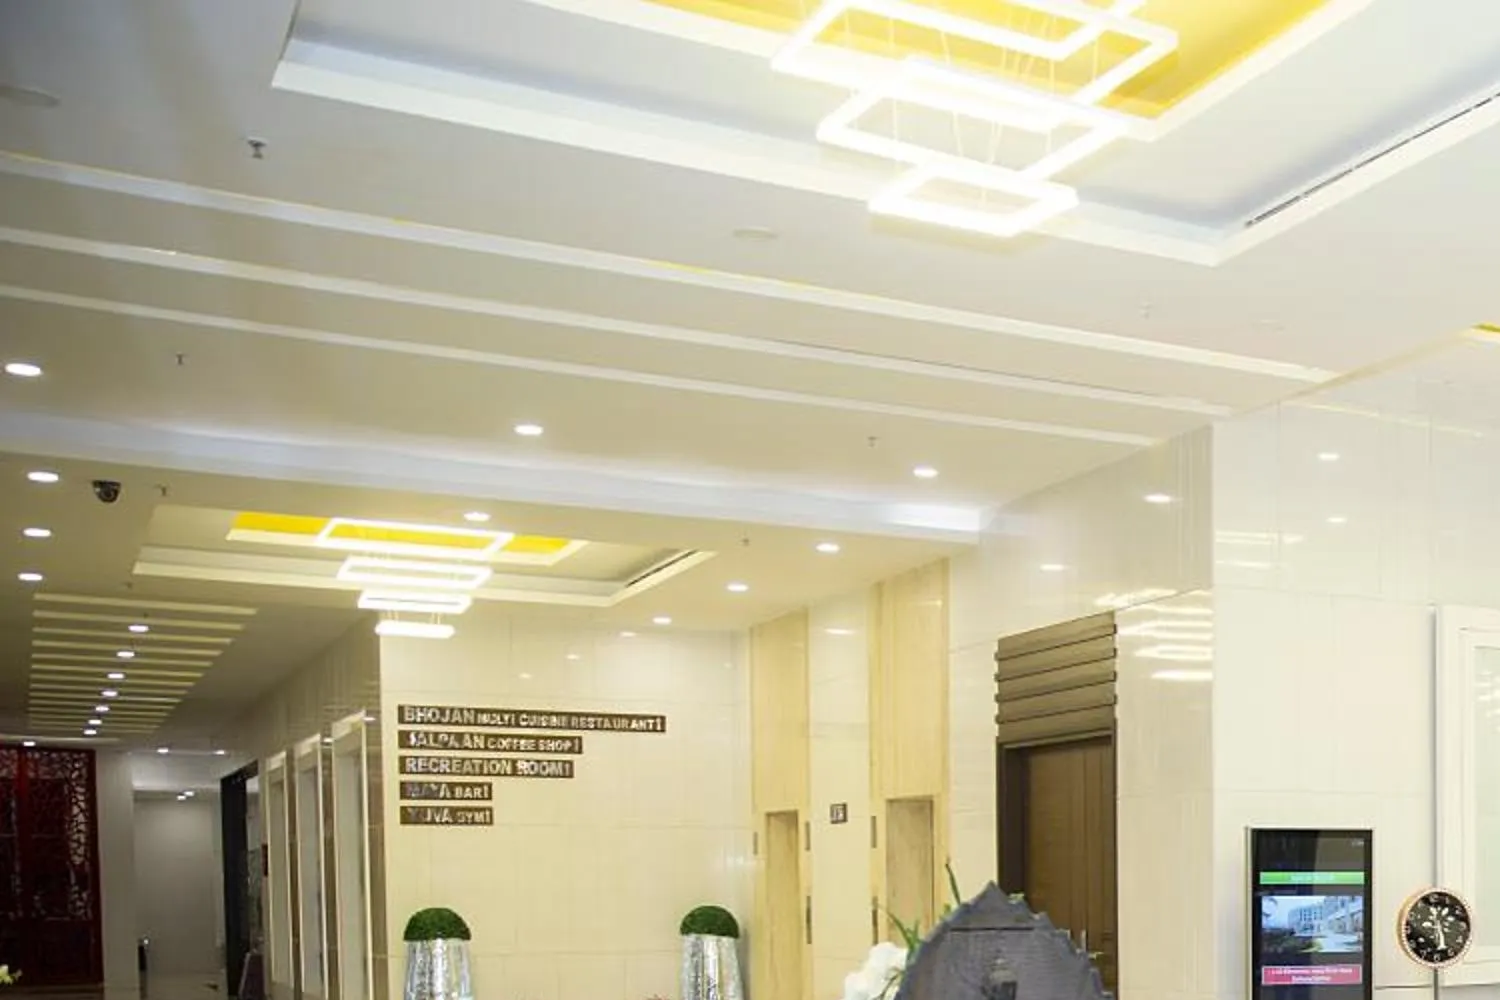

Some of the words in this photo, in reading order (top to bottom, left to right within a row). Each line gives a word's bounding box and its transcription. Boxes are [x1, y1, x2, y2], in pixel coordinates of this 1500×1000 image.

[403, 705, 475, 724] BHOJAN
[571, 715, 655, 730] RESTAURANT
[487, 737, 536, 751] COFFEE
[537, 738, 573, 752] SHOP
[404, 757, 512, 775] RECREATION
[516, 760, 563, 776] ROOM
[454, 786, 484, 799] BAR
